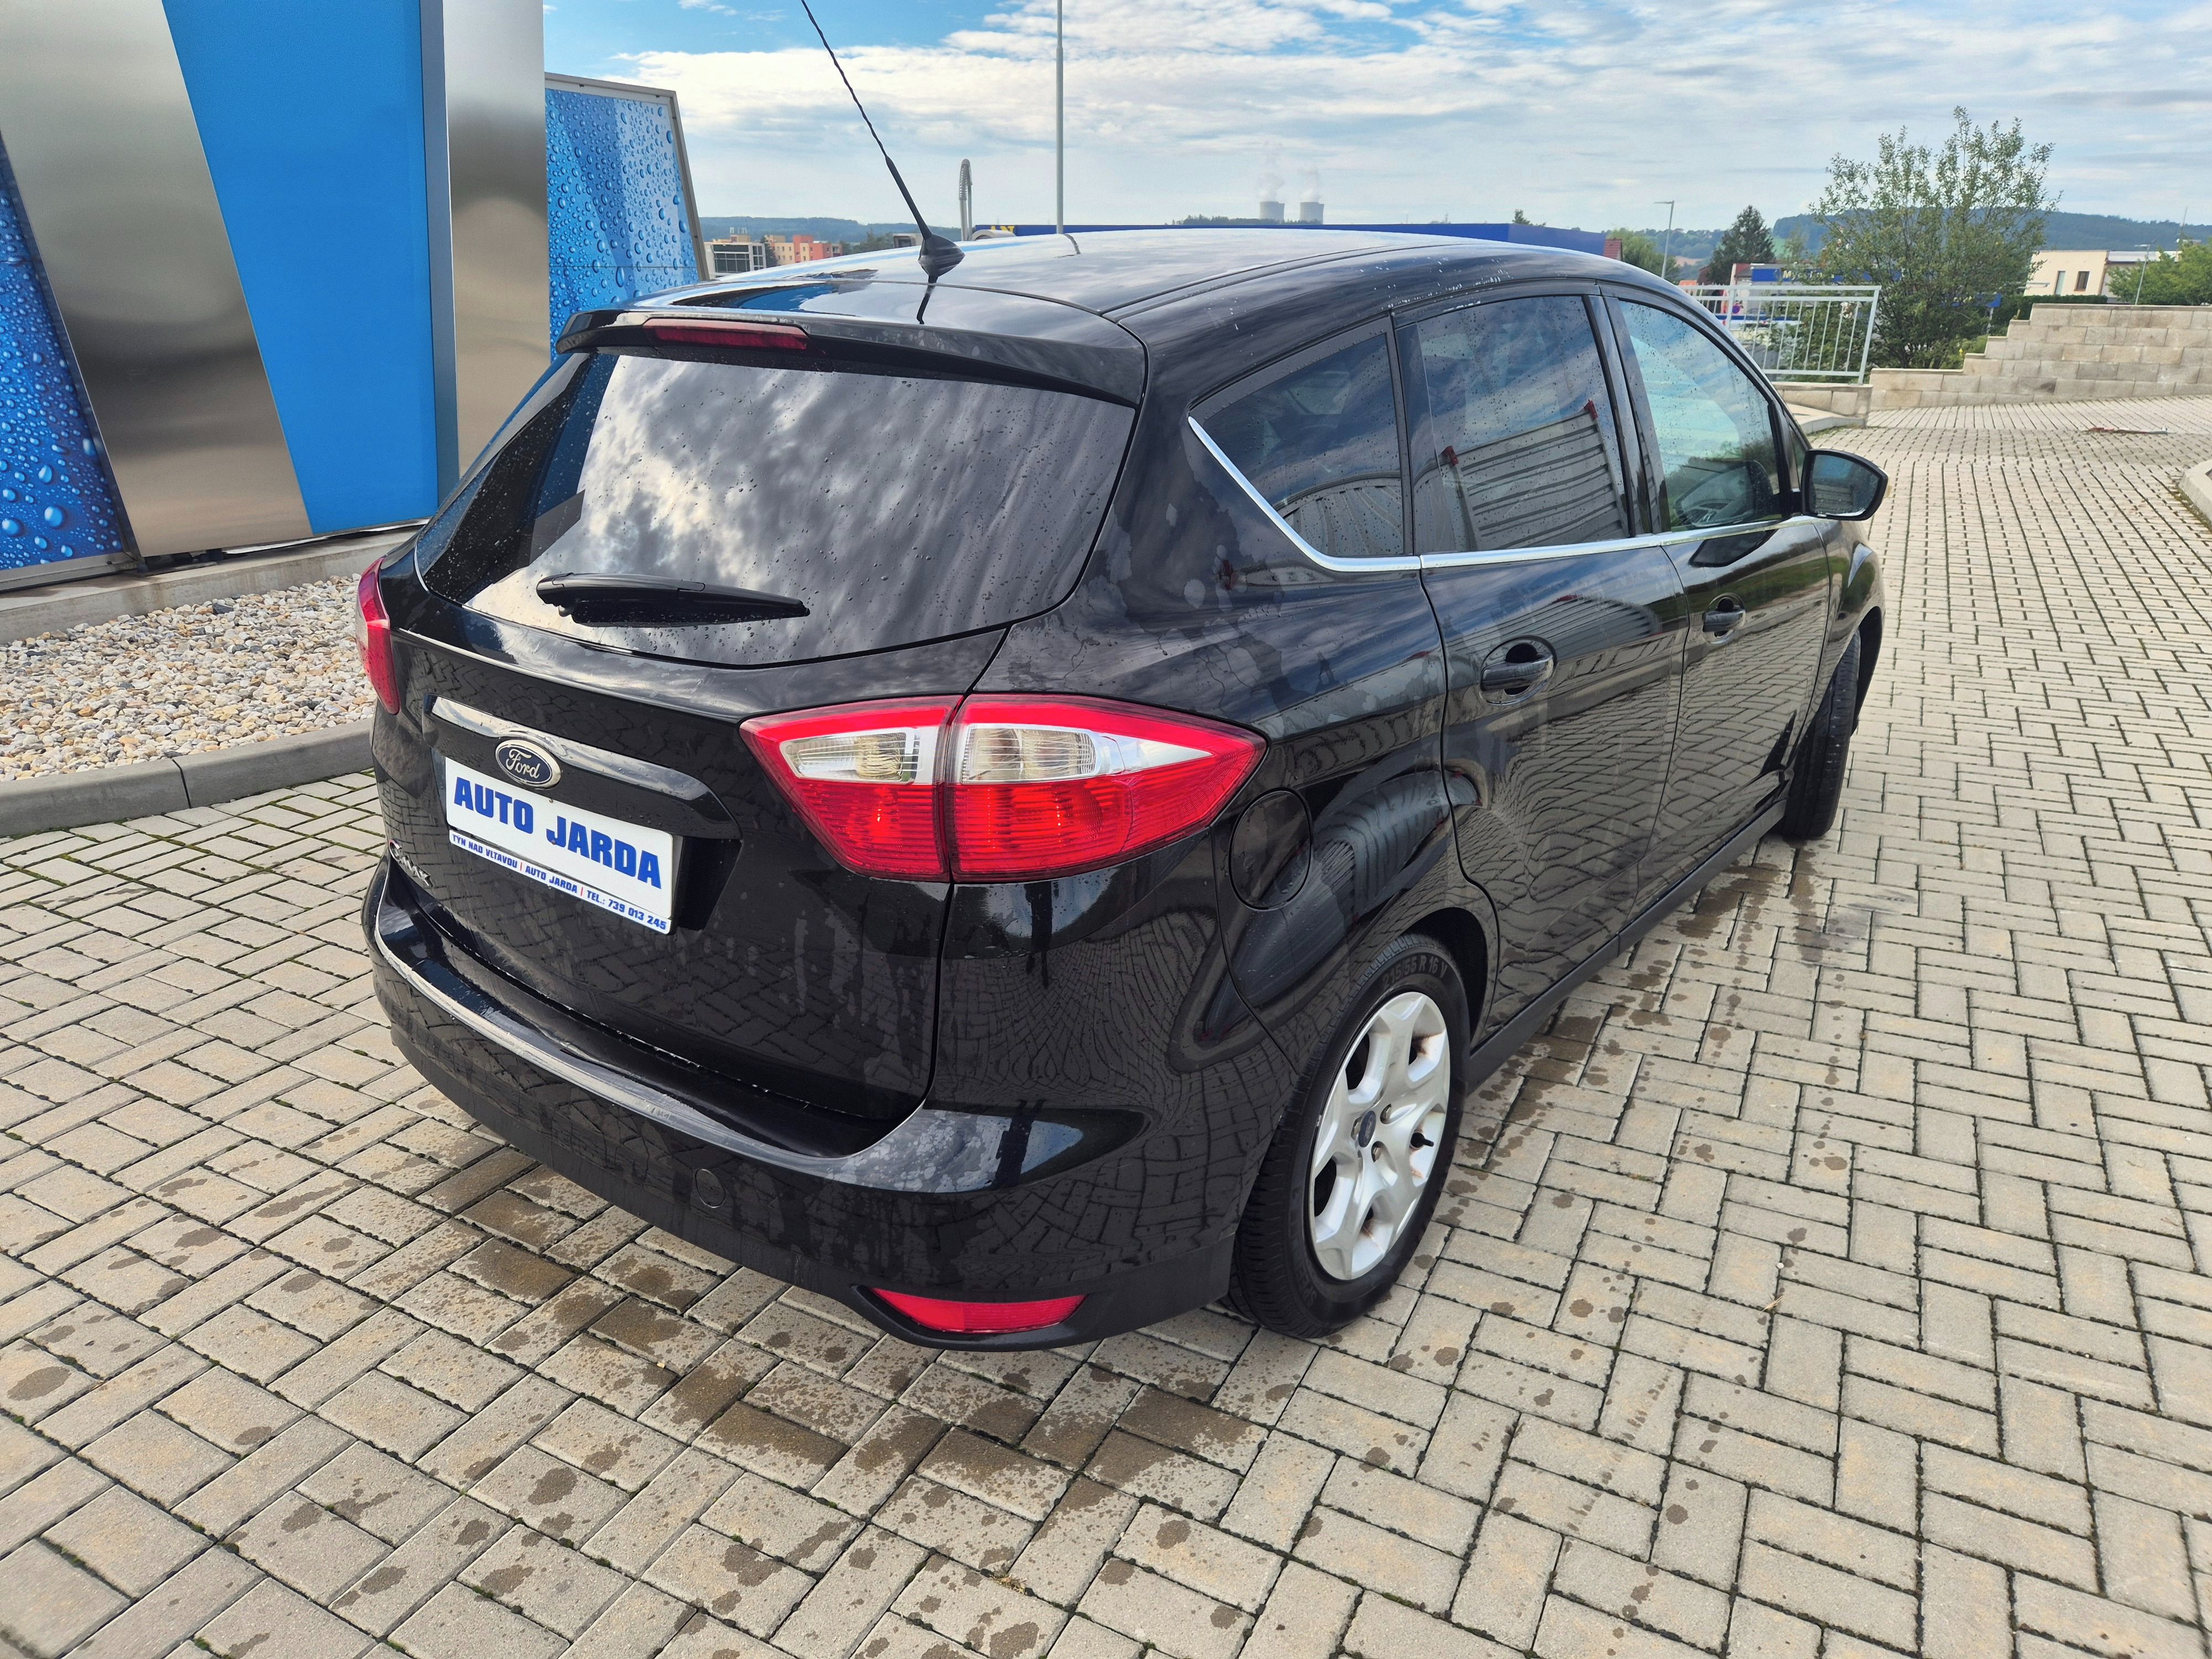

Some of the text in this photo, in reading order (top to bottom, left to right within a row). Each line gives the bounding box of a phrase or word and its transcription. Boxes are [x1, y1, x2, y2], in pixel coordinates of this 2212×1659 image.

[505, 748, 541, 779] Ford
[453, 776, 662, 890] AUTO JARDA
[468, 841, 483, 854] NAD
[486, 848, 518, 869] VLTAVOU
[525, 865, 546, 880] AUTO
[549, 875, 578, 894] JARDA
[587, 890, 605, 905] TEL.:
[608, 899, 625, 912] 739
[628, 907, 644, 921] 013
[647, 915, 666, 930] 245
[1383, 954, 1448, 990] 215/55 R 16 V
